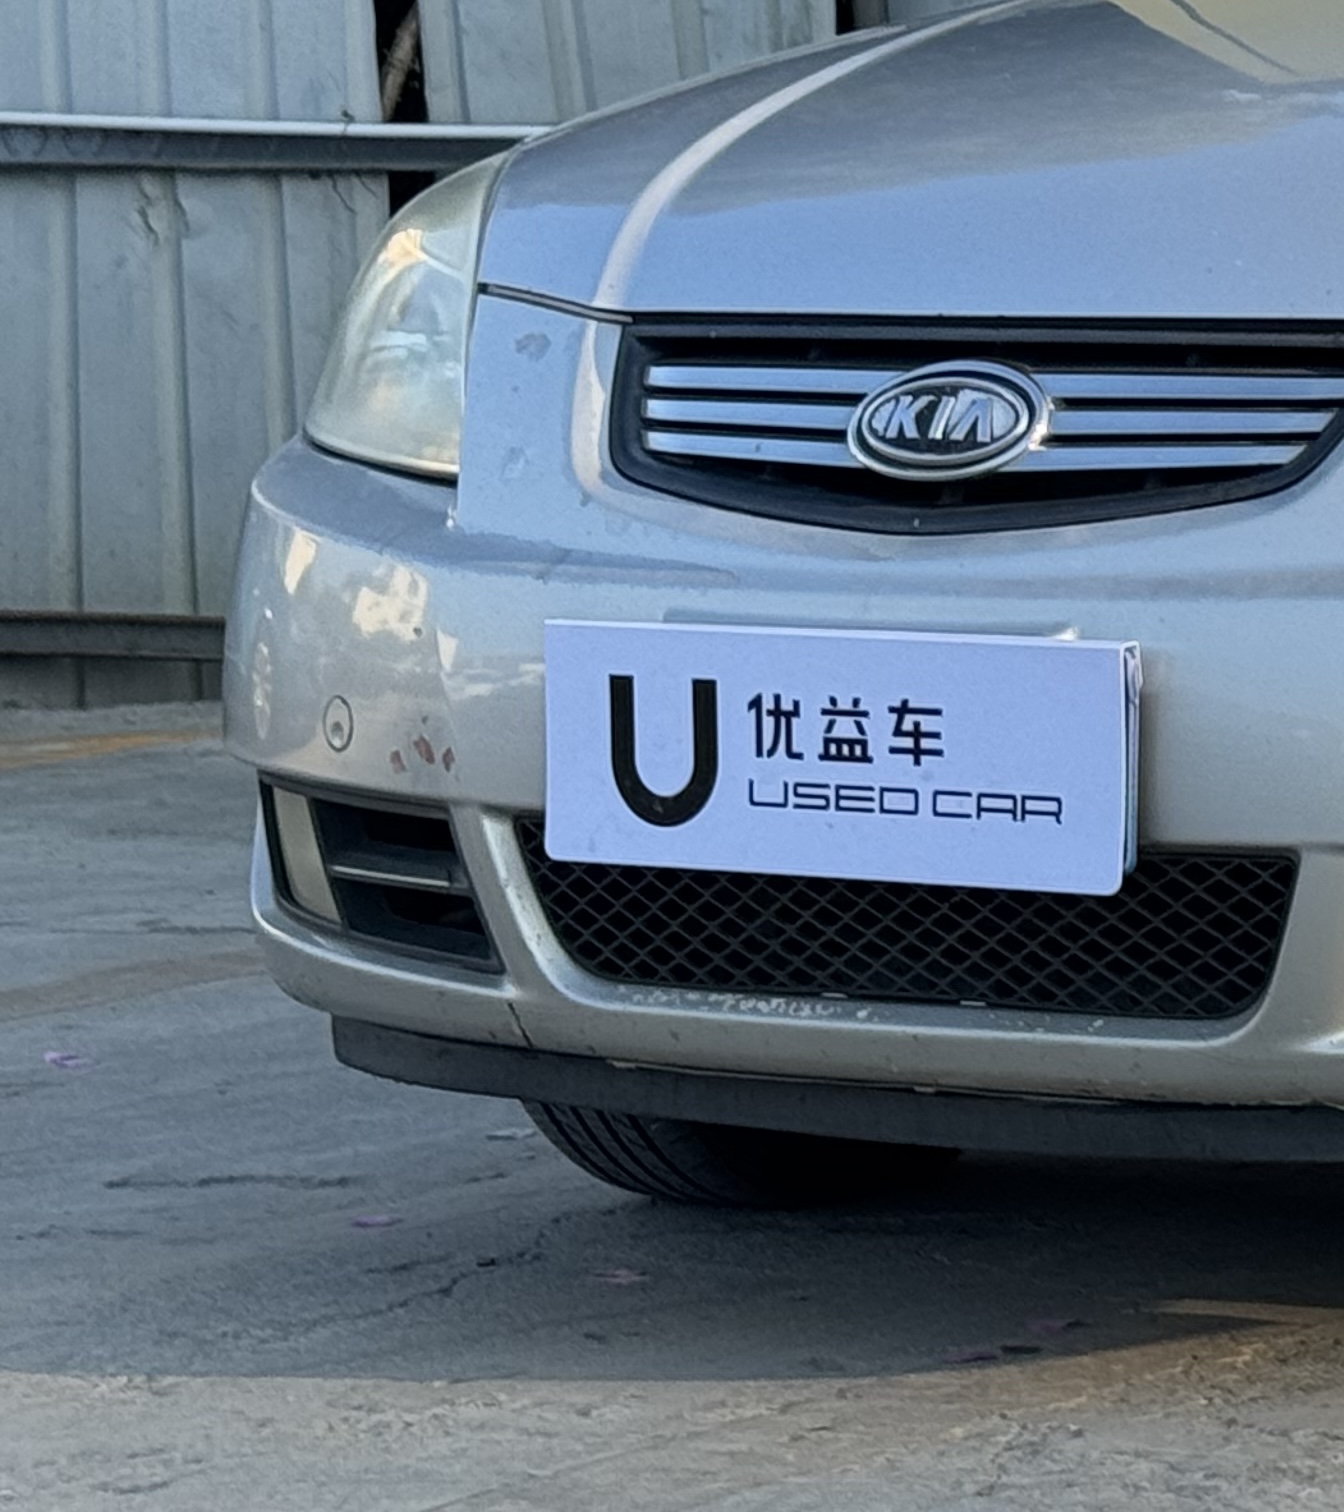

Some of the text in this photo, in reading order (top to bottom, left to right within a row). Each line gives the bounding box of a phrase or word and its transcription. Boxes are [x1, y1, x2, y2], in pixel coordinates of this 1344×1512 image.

[884, 390, 994, 444] KIA
[609, 673, 719, 828] U
[747, 692, 945, 767] 优益车
[748, 779, 1062, 825] USED CAR
